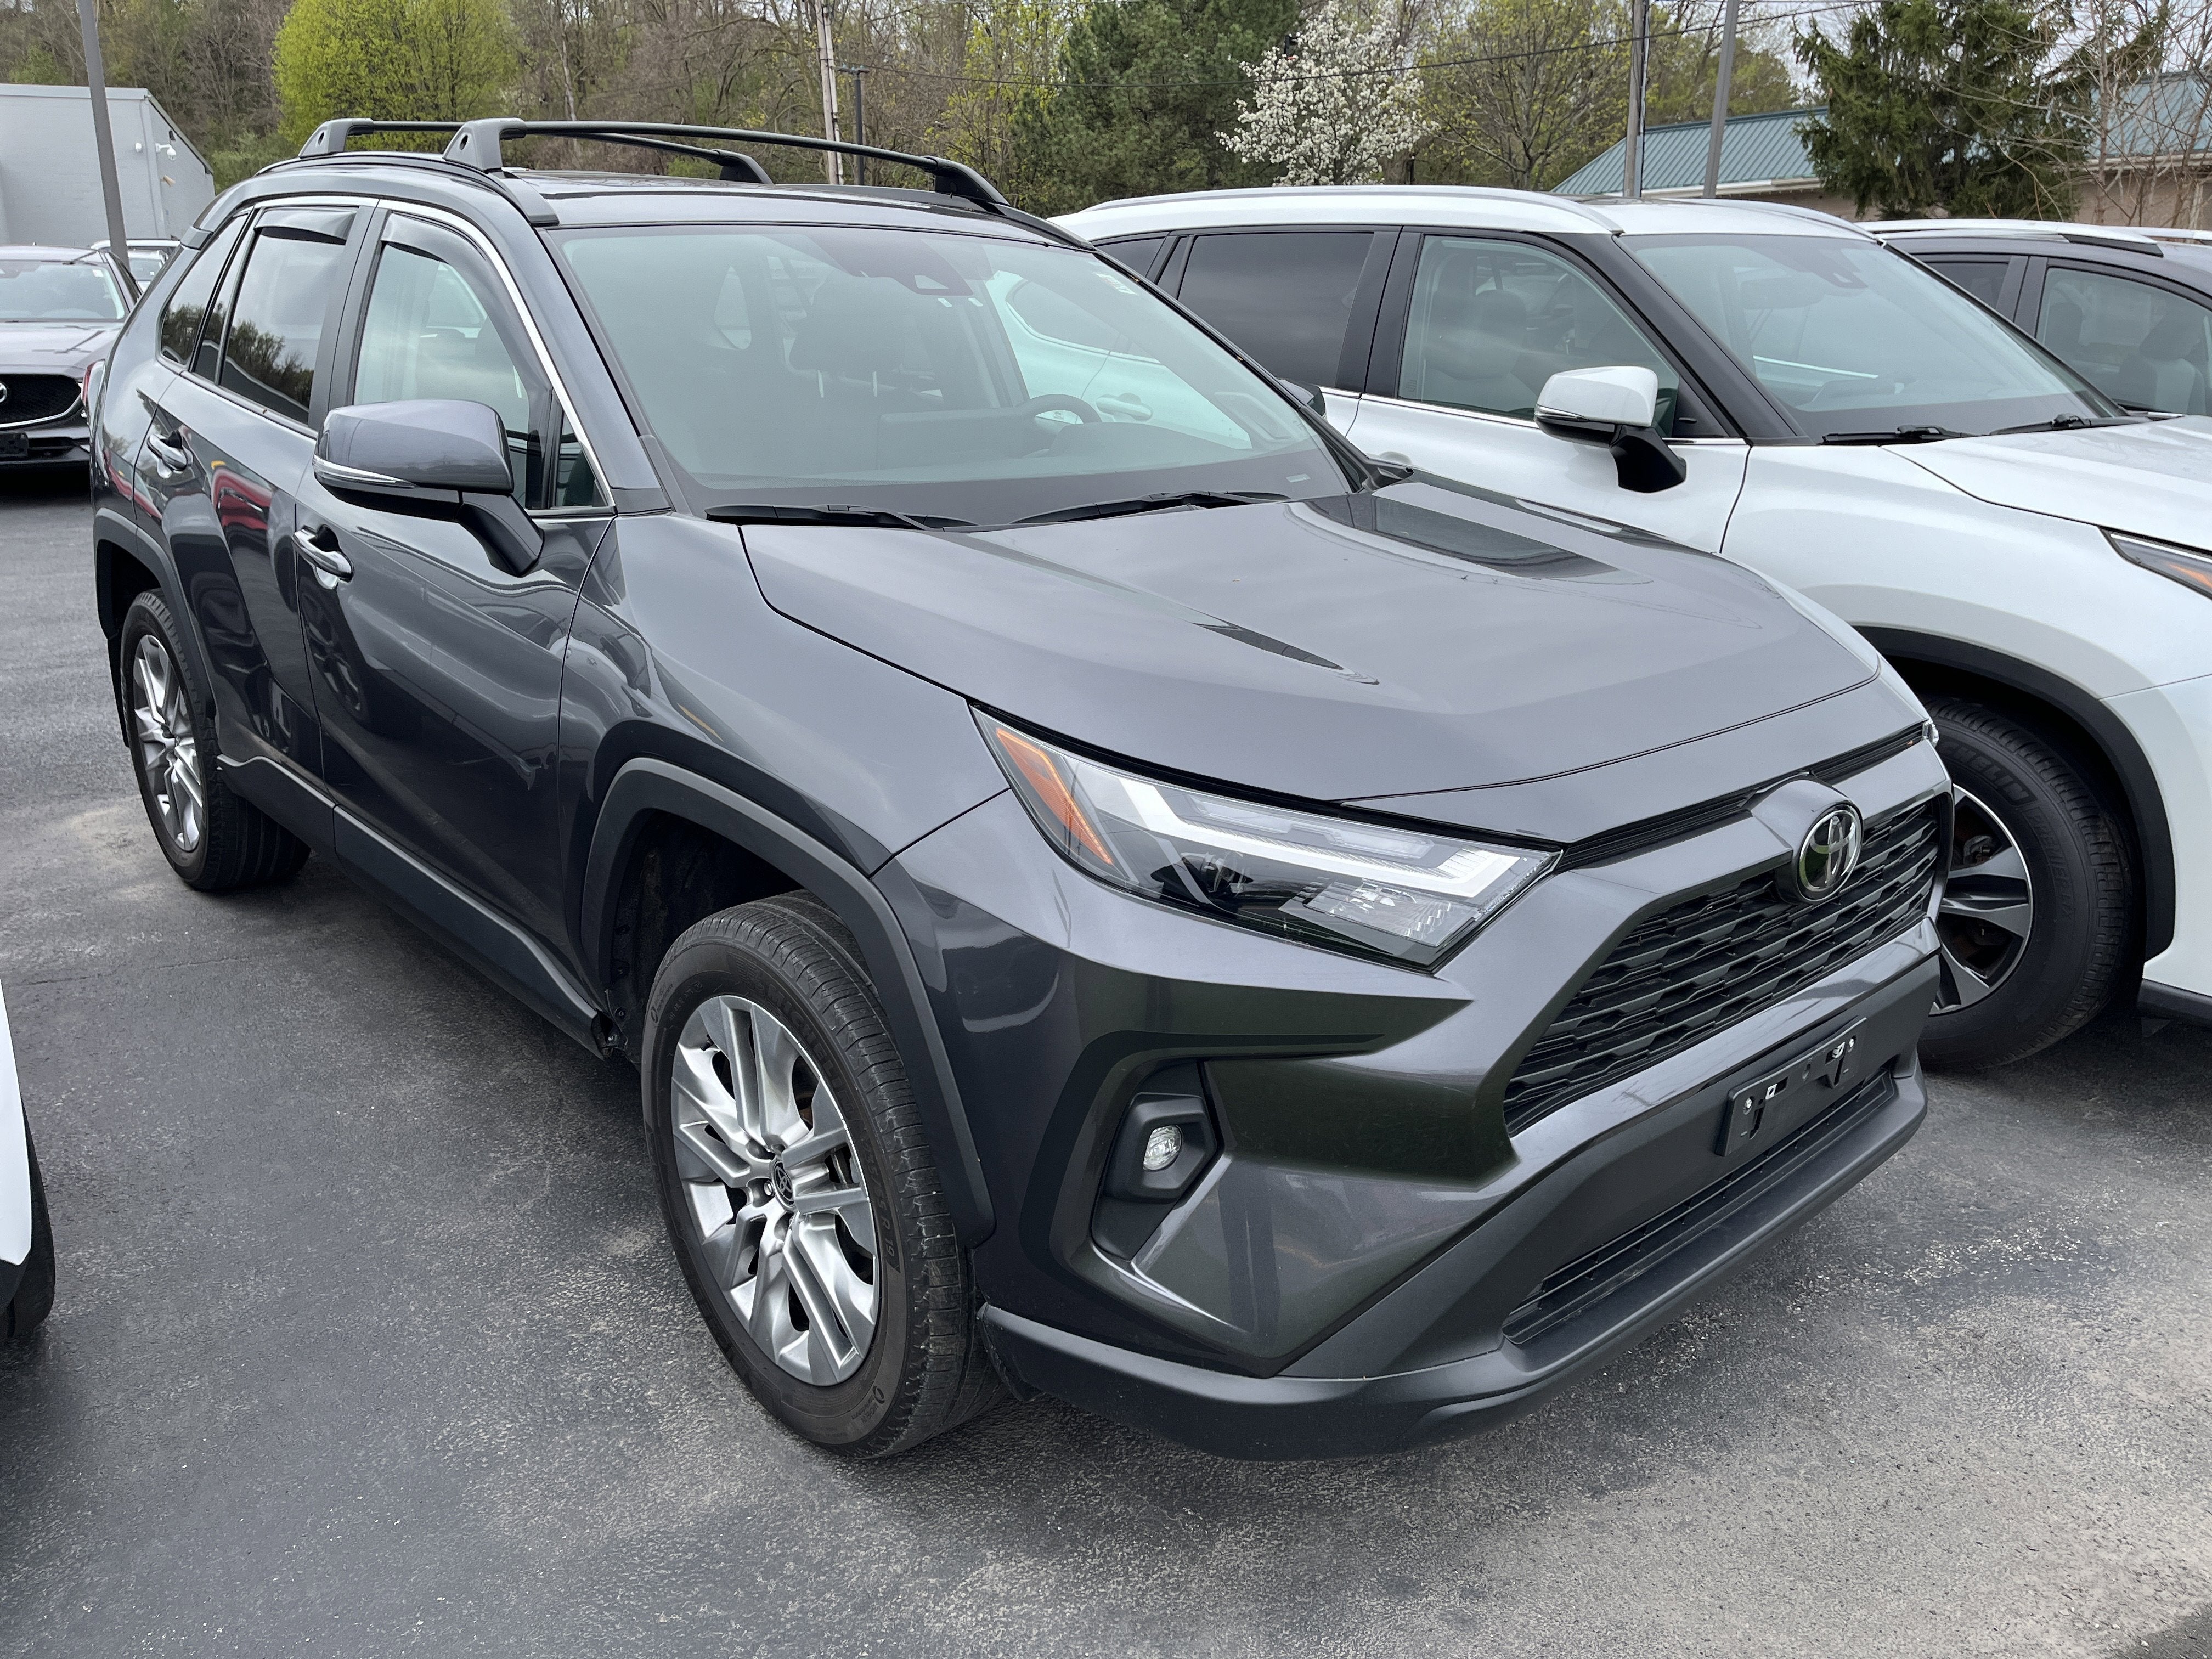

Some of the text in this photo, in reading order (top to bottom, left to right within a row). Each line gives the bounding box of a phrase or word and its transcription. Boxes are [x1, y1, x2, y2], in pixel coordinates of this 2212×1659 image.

[1938, 741, 2029, 801] CHELIN
[767, 980, 855, 1116] MICHELIN
[862, 1141, 895, 1258] 235/55 R 19
